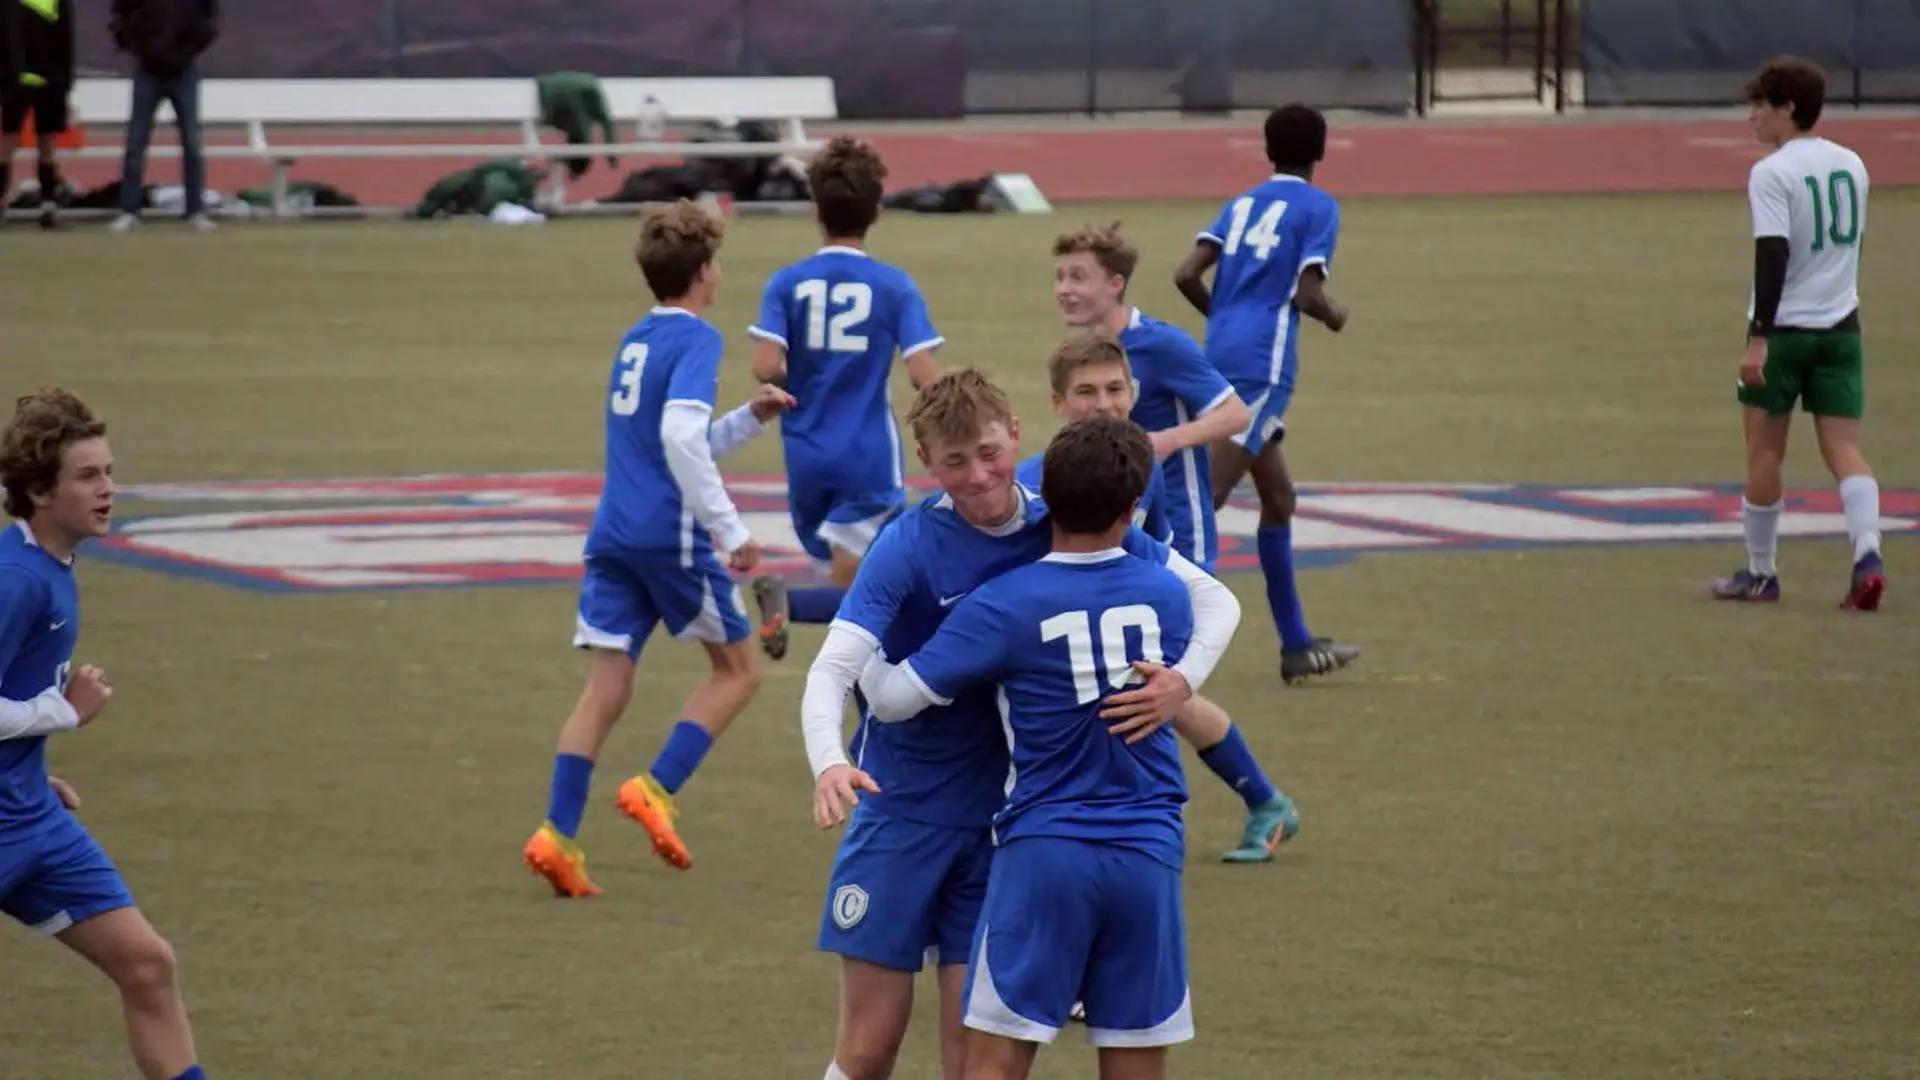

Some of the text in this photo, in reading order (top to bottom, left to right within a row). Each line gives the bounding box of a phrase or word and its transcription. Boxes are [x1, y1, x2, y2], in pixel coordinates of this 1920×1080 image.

[1224, 196, 1288, 259] 14
[1804, 170, 1857, 250] 10
[795, 279, 872, 351] 12
[612, 342, 648, 415] 3
[1040, 604, 1165, 704] 10
